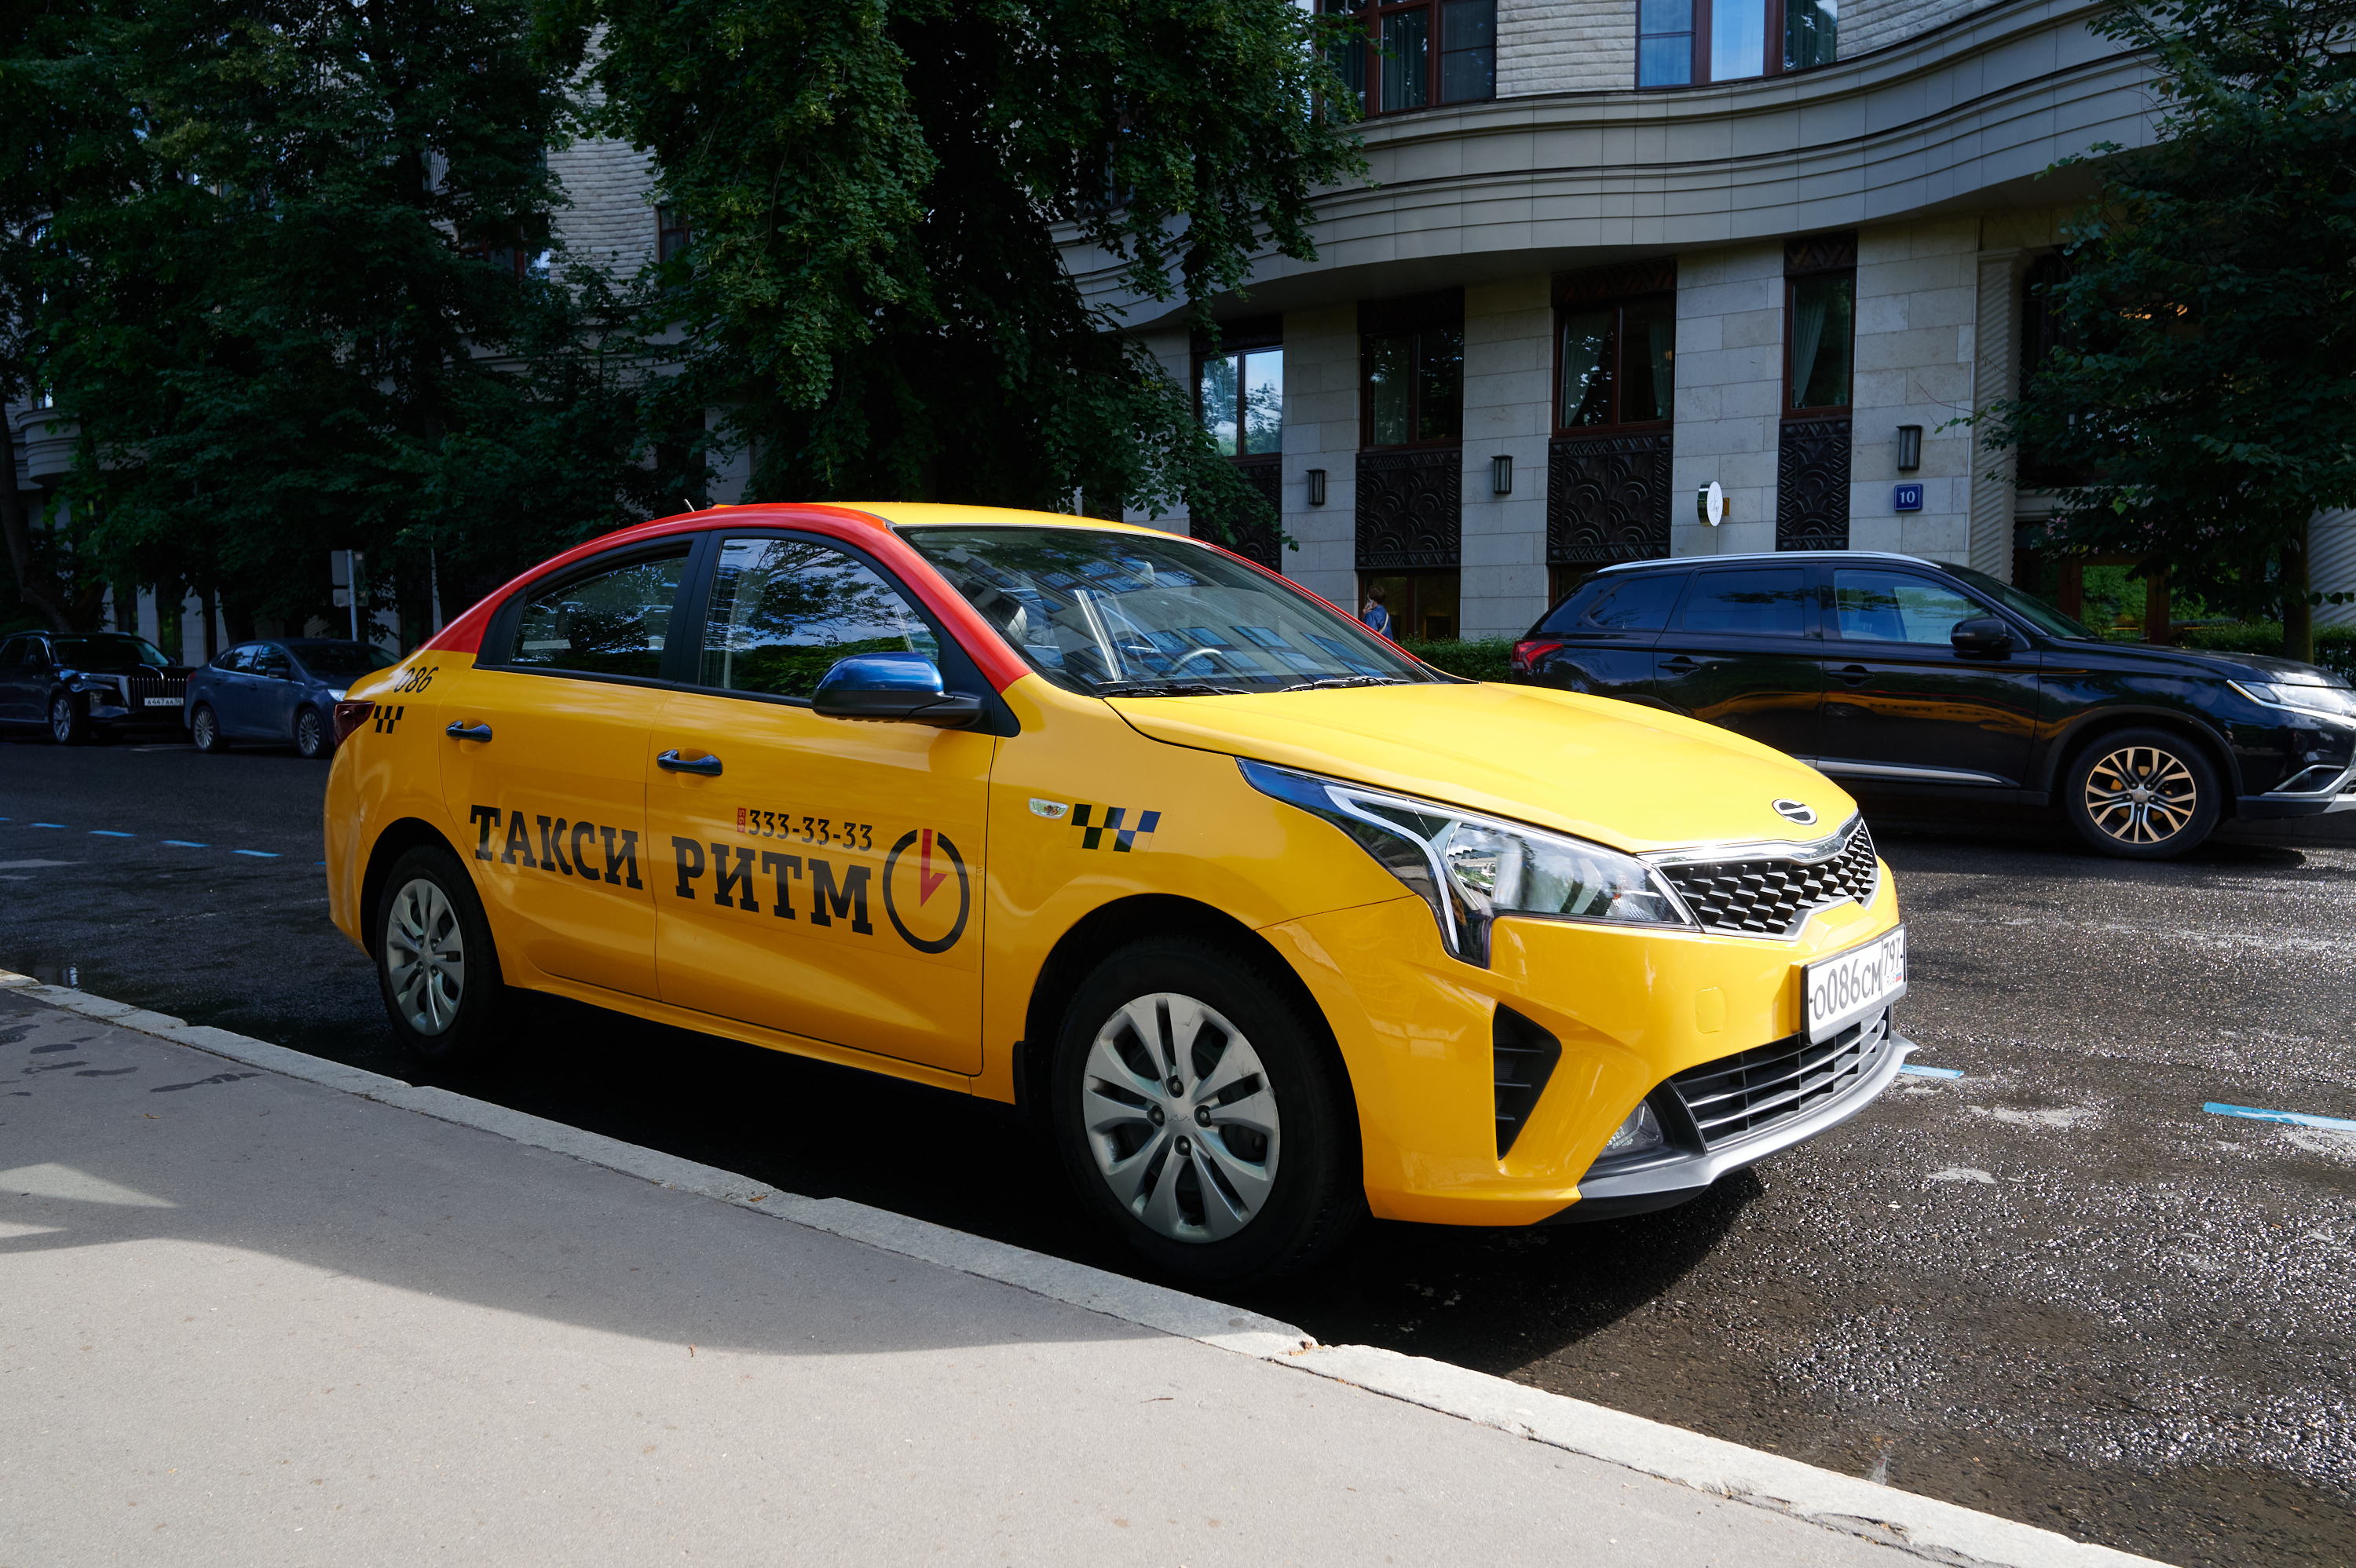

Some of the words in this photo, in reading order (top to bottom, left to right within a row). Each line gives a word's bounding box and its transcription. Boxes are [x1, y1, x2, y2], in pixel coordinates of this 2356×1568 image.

[1900, 491, 1915, 504] 10
[394, 667, 439, 693] 086
[748, 810, 873, 853] 333-33-33
[469, 804, 643, 891] ТАКСИ
[671, 836, 873, 937] РИТМ
[1814, 958, 1882, 1020] О086СМ
[1886, 972, 1896, 988] RUS
